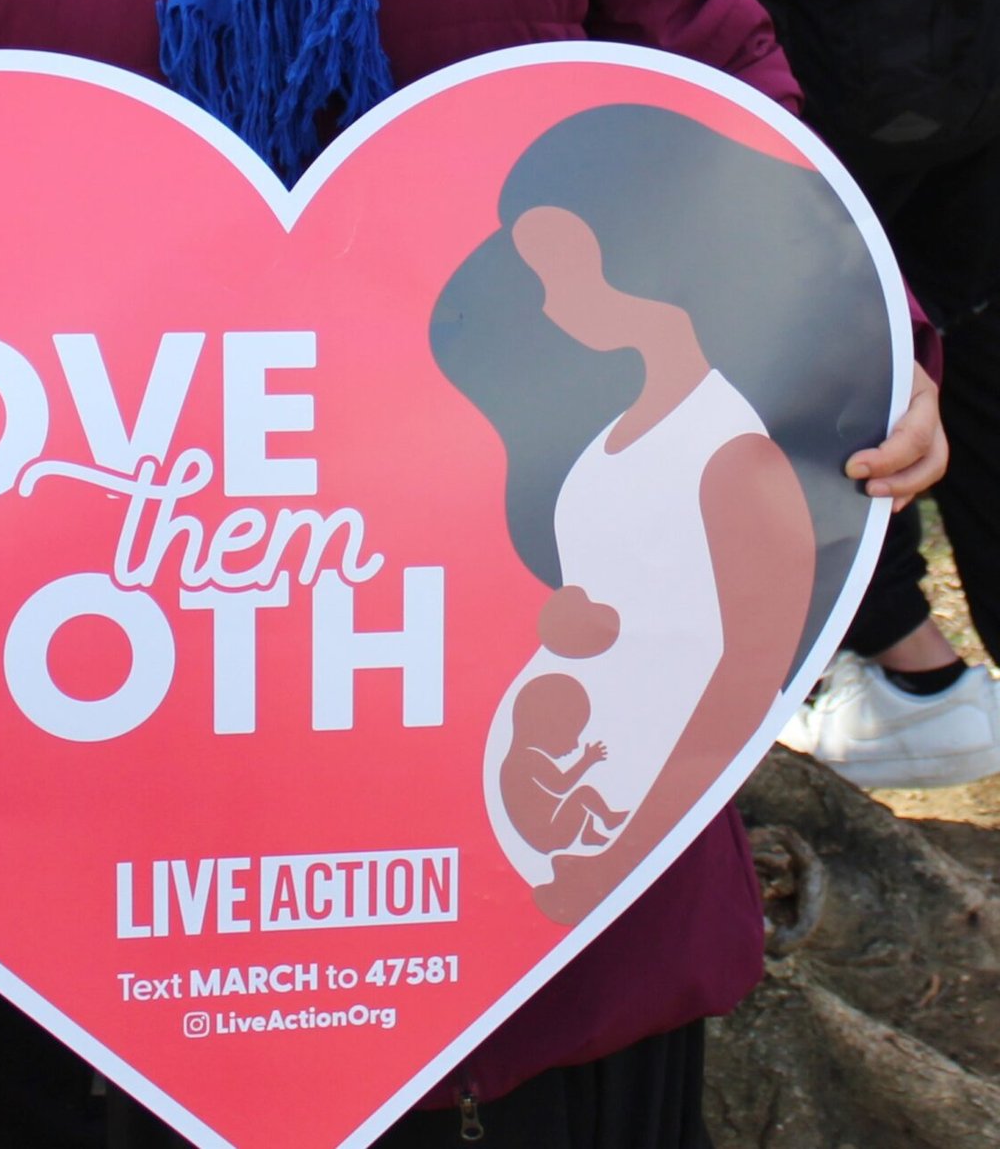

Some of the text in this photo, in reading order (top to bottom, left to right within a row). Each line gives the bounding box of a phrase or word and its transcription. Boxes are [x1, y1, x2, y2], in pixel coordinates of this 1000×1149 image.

[18, 447, 385, 588] them
[116, 857, 451, 939] LIVE ACTION
[117, 955, 459, 1002] Text MARCH to 47581
[215, 1004, 397, 1036] LiveActionOrg
